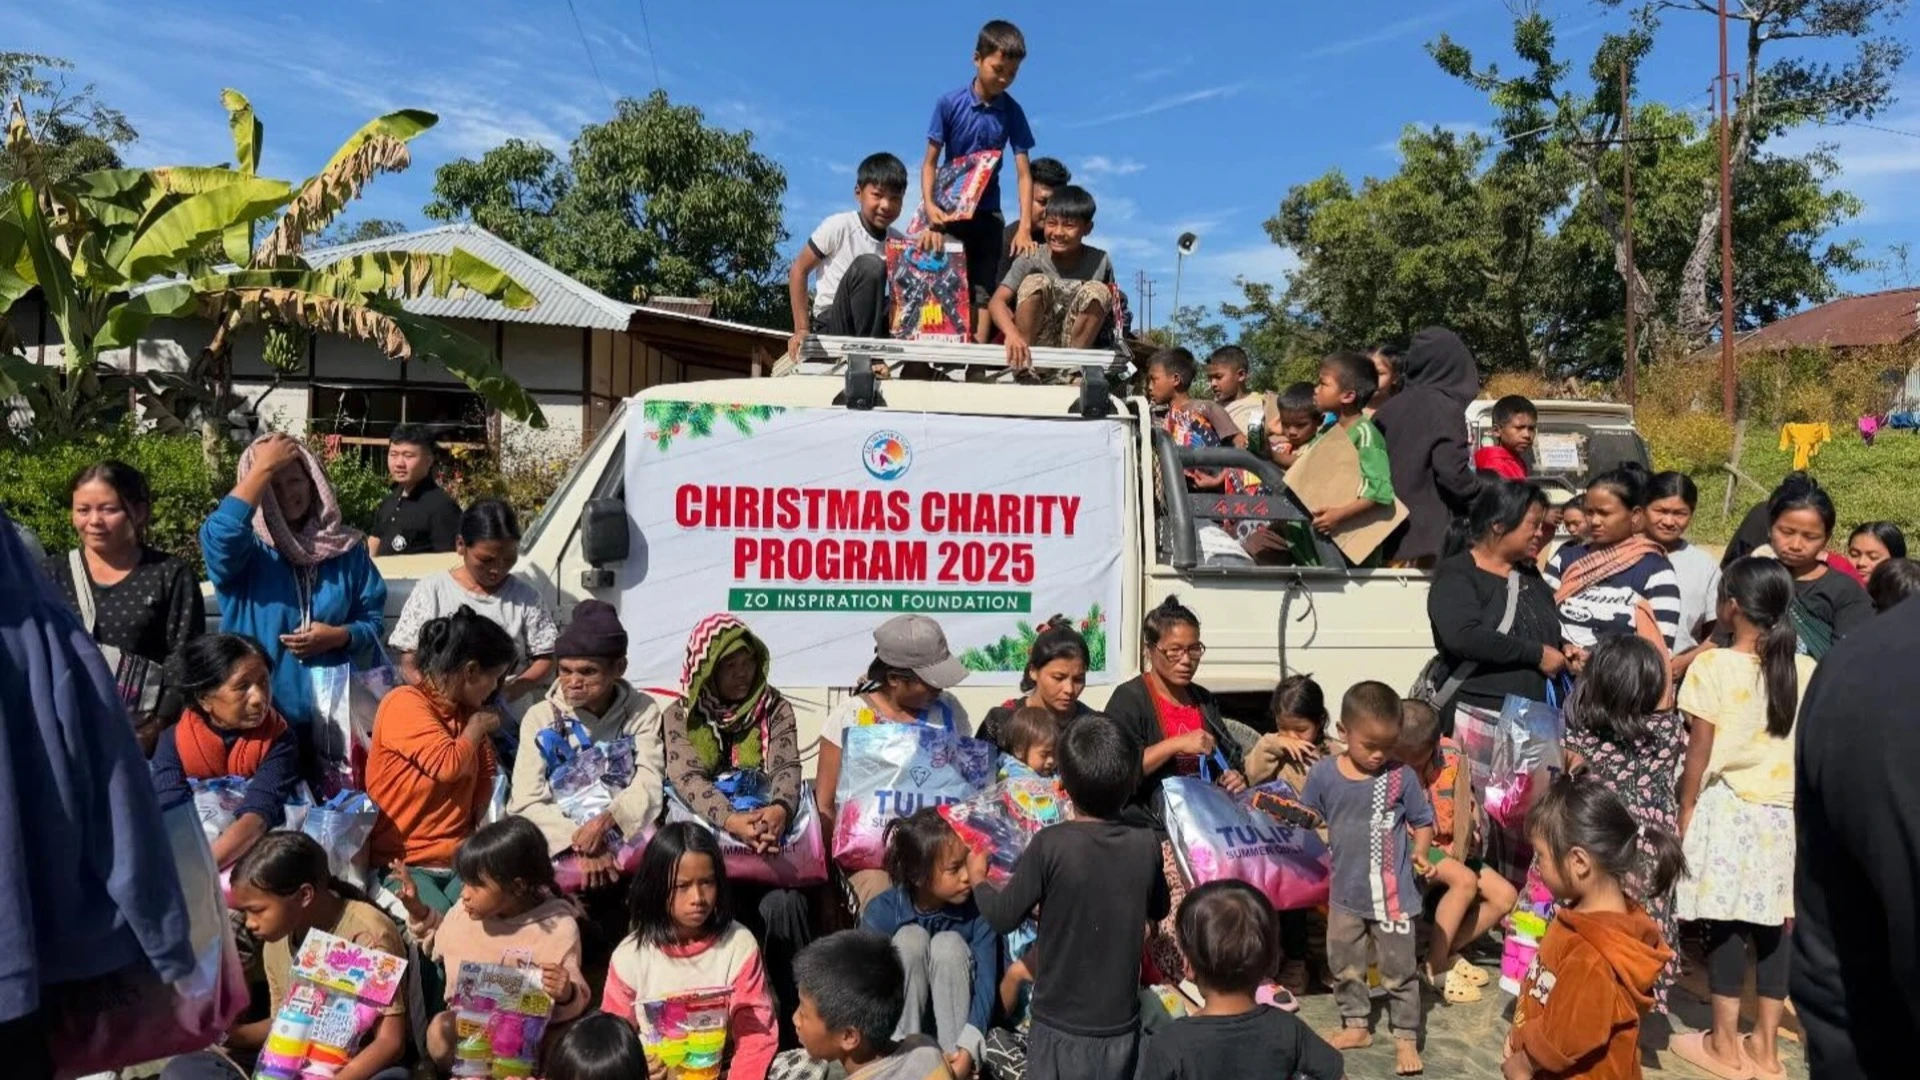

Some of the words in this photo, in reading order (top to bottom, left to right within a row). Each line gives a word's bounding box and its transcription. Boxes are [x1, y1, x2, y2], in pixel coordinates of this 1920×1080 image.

[675, 484, 910, 533] CHRISTMAS
[921, 491, 1081, 535] CHARITY
[734, 537, 927, 581] PROGRAM
[937, 541, 1035, 584] 2025
[744, 593, 769, 608] ZO
[778, 593, 893, 609] INSPIRATION
[902, 595, 1018, 609] FOUNDATION
[1215, 825, 1294, 848] TULIP
[1226, 846, 1275, 859] SUMMER
